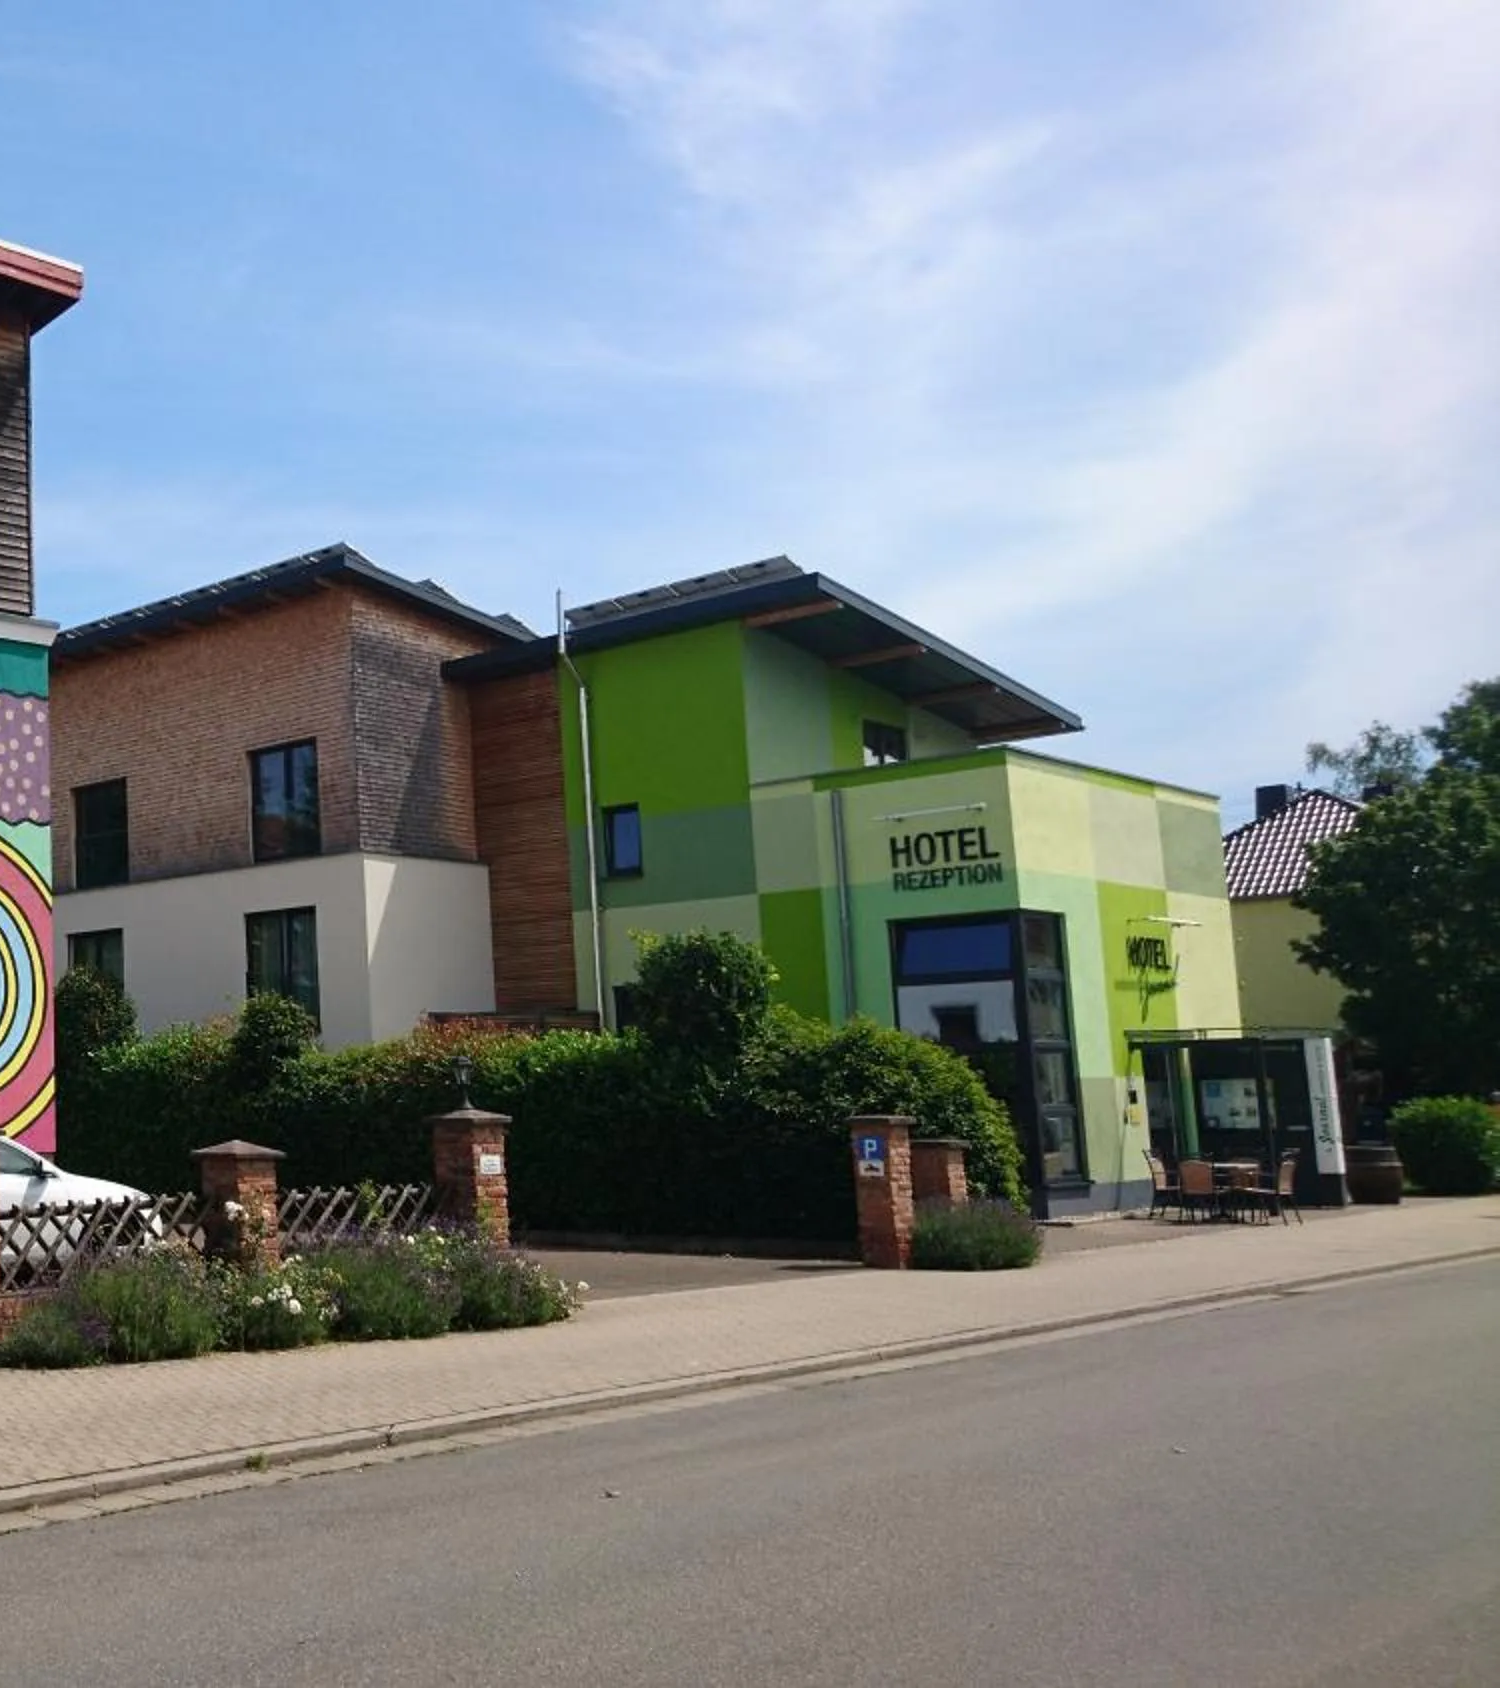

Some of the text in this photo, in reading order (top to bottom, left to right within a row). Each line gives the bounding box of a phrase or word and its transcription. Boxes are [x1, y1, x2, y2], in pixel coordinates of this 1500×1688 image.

[890, 826, 1000, 868] HOTEL
[893, 863, 1003, 892] REZEPTION
[1127, 936, 1172, 971] HOTEL
[864, 1139, 877, 1160] P
